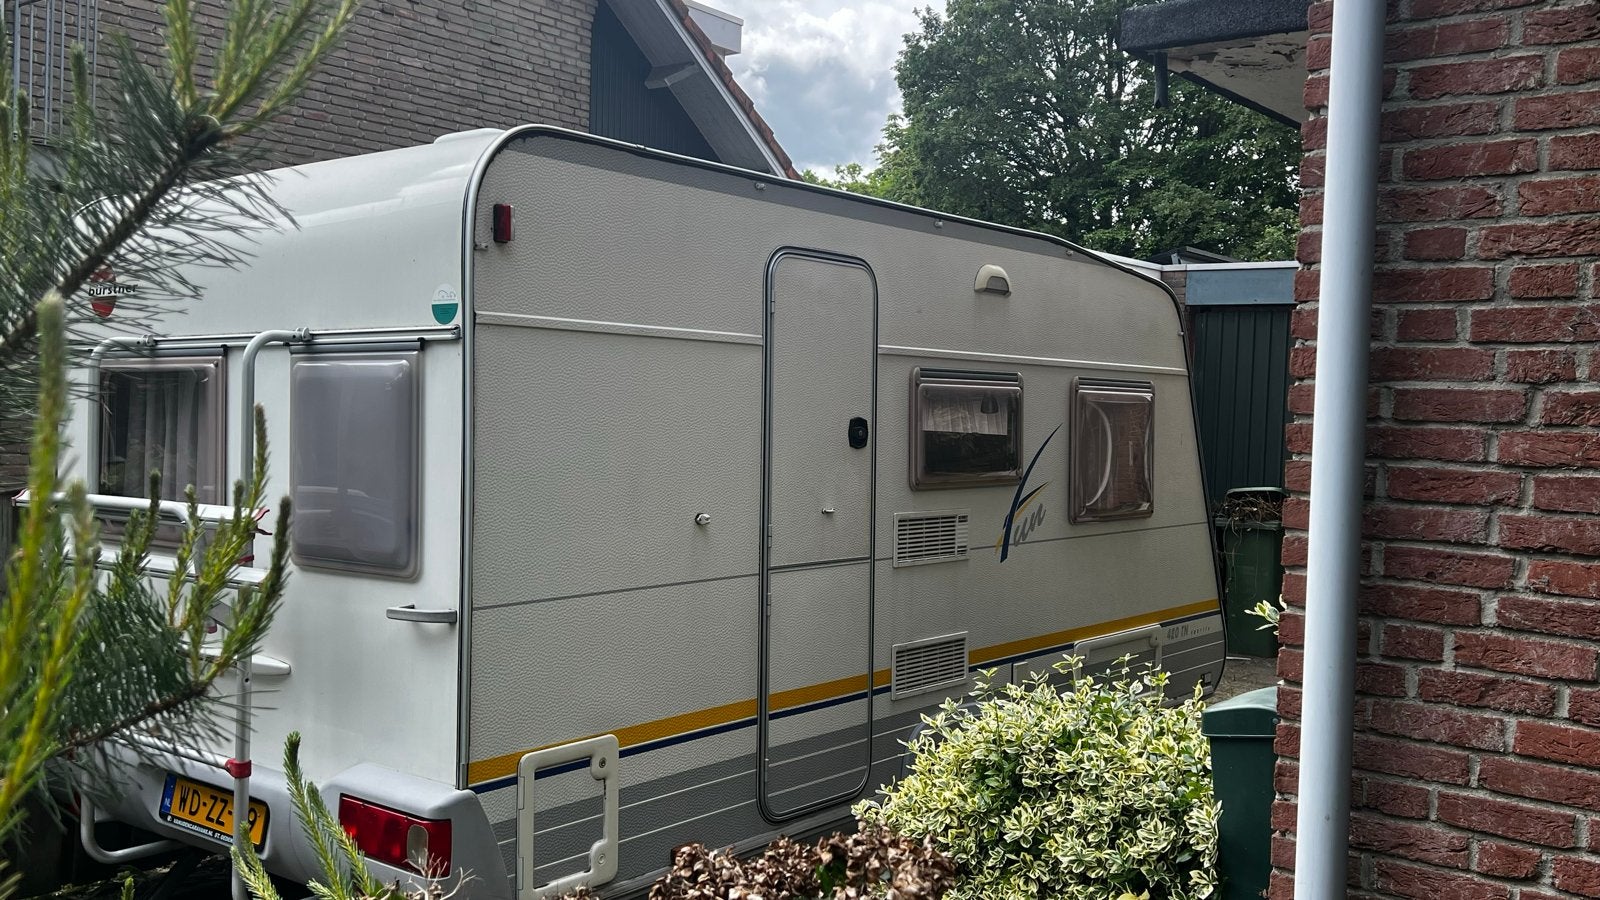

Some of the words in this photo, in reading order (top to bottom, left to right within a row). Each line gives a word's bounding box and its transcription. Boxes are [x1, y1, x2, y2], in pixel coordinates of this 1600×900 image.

[88, 284, 138, 296] bürstner
[164, 798, 171, 808] NL
[178, 784, 258, 832] WD-ZZ-9
